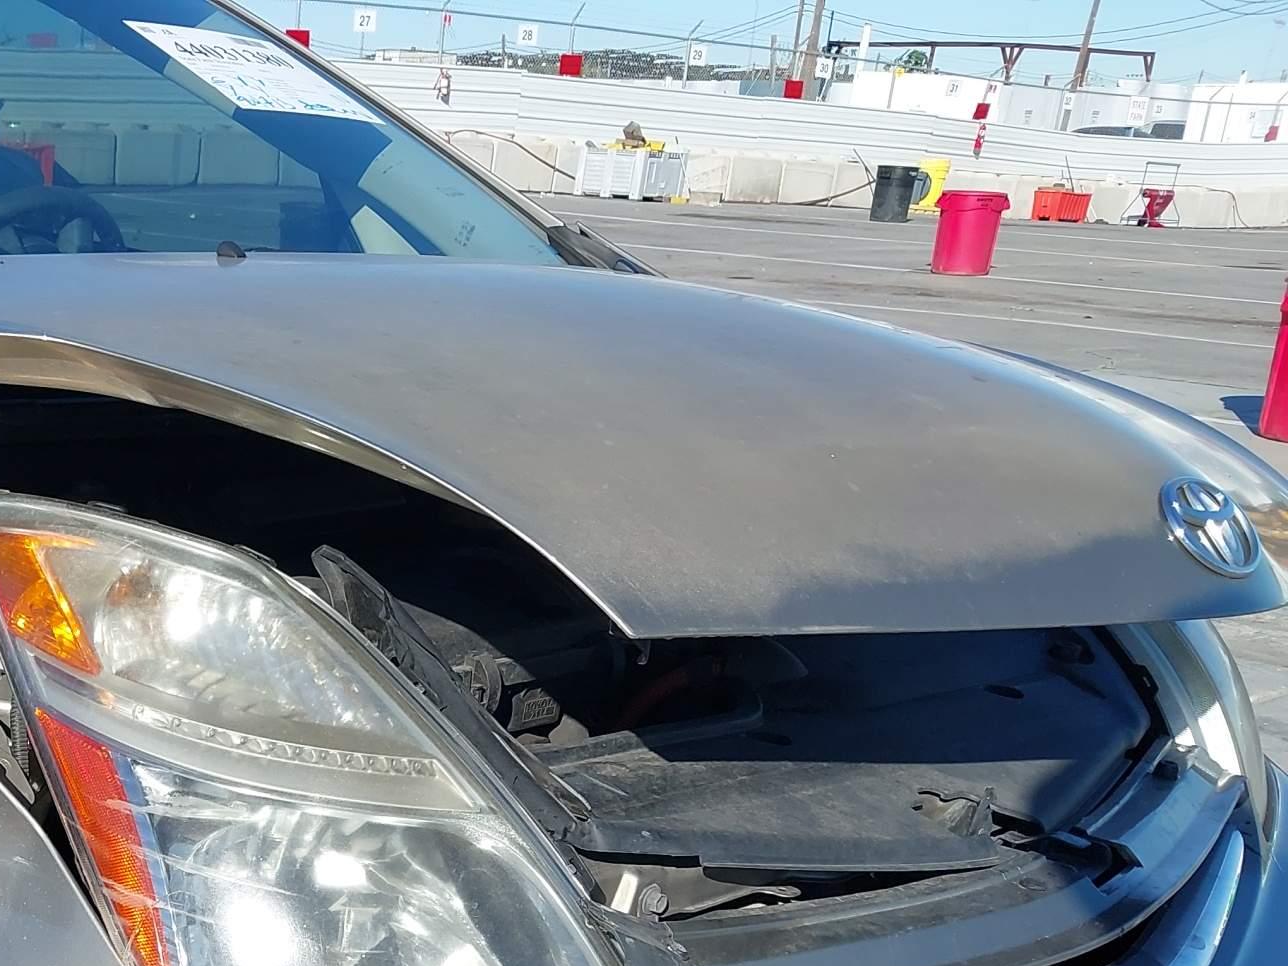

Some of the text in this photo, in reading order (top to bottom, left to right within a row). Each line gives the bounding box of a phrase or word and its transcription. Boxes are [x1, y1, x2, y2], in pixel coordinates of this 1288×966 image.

[359, 15, 371, 27] 27
[522, 29, 533, 41] 28
[174, 41, 295, 70] 44031380
[692, 49, 703, 61] 29
[819, 63, 829, 74] 30
[949, 83, 959, 93] 31
